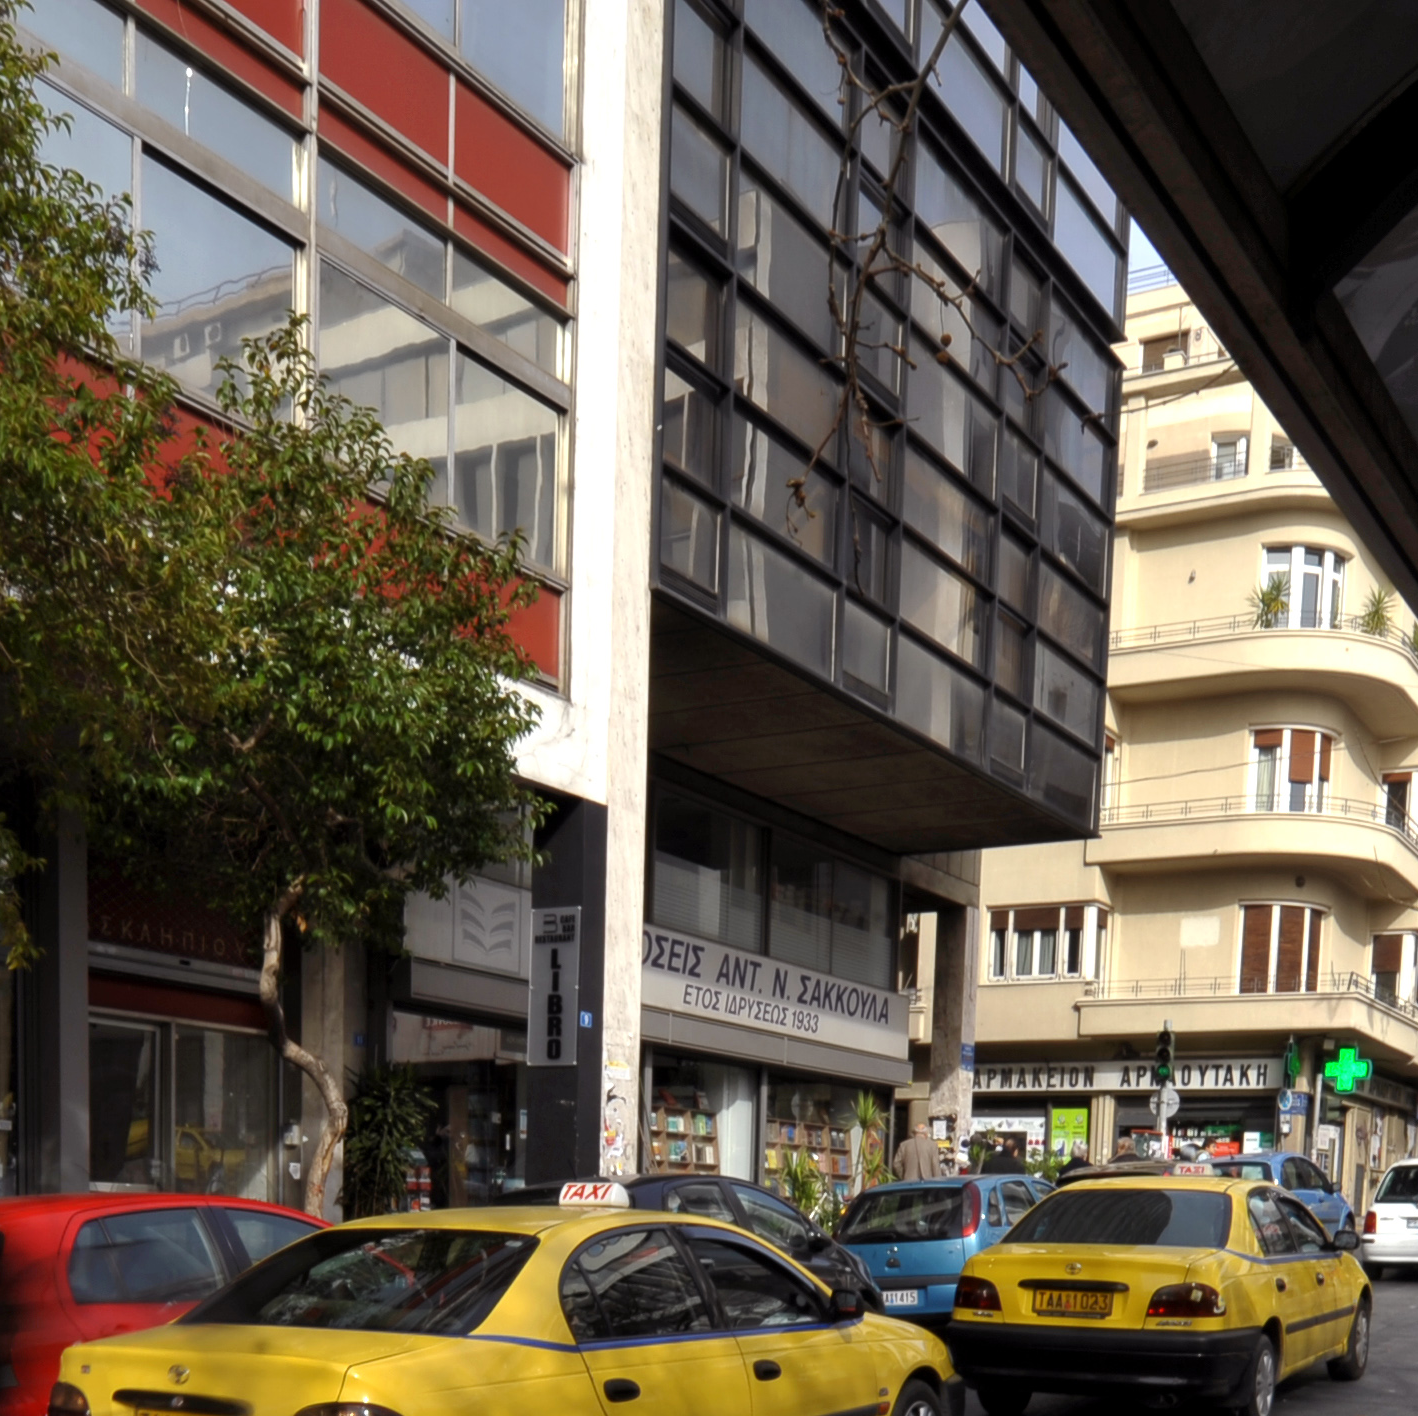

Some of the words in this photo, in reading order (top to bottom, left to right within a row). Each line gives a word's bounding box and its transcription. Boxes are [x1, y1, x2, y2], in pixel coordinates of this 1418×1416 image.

[547, 948, 562, 1060] LIBRO
[716, 953, 763, 994] ΑΝΤ.
[772, 967, 790, 1001] Ν.
[797, 975, 889, 1025] ΣΑΚΚΟΥΛΑ
[683, 984, 722, 1012] ΕΤΟΣ
[724, 993, 789, 1027] ΙΔΡΥΣΕΩΣ
[792, 1009, 819, 1034] 1933
[1178, 1165, 1205, 1175] TAXI
[562, 1184, 613, 1201] TAXI
[1038, 1291, 1062, 1309] TAA
[1073, 1293, 1109, 1311] 1023
